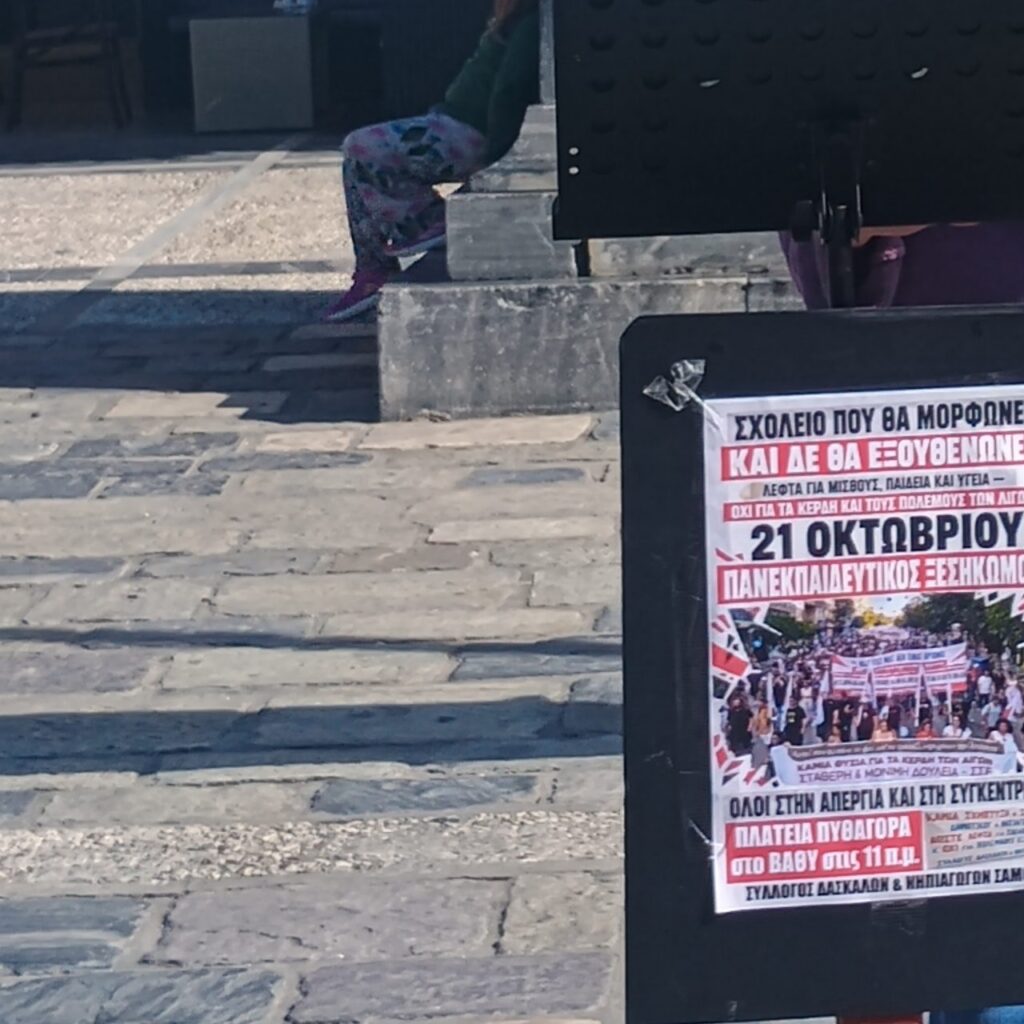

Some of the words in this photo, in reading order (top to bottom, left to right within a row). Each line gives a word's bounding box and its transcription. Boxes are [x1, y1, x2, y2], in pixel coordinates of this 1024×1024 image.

[734, 410, 826, 441] ΣΧΟΛΕΙΟ
[833, 407, 875, 435] ΠΟΥ
[882, 406, 911, 432] ΘΑ
[728, 446, 779, 478] ΚΑΙ
[786, 444, 820, 474] ΔΕ
[826, 441, 862, 472] ΘΑ
[762, 482, 803, 497] ΛΕΦΤΑ
[806, 481, 825, 494] ΓΙΑ
[828, 477, 883, 493] ΜΙΣΘΟΥΣ,
[886, 475, 931, 490] ΠΑΙΔΕΙΑ
[934, 474, 955, 488] ΚΑΙ
[957, 472, 990, 487] ΥΓΕΙΑ
[751, 522, 792, 561] 21
[806, 512, 1024, 556] ΟΚΤΩΒΡΙΟΥ
[724, 559, 922, 600] ΠΑΝΕΚΠΑΙΔΕΥΤΙΚΟΣ
[730, 796, 771, 818] ΟΛΟΙ
[775, 793, 815, 815] ΣΤΗΝ
[820, 788, 884, 812] ΑΠΕΡΓΙΑ
[889, 786, 915, 808] ΚΑΙ
[919, 784, 946, 806] ΣΤΗ
[735, 823, 813, 848] ΠΛΑΤΕΙΑ
[816, 815, 912, 844] ΠΥΘΑΓΟΡΑ
[731, 857, 765, 876] στο
[769, 849, 818, 874] ΒΑΘΥ
[822, 850, 860, 871] στις
[863, 846, 882, 867] 11
[885, 846, 920, 867] π.μ.
[746, 883, 814, 901] ΣΥΛΛΟΓΟΣ
[817, 877, 889, 896] ΔΑΣΚΑΛΩΝ
[906, 871, 991, 890] ΝΗΠΙΑΓΩΓΩΝ
